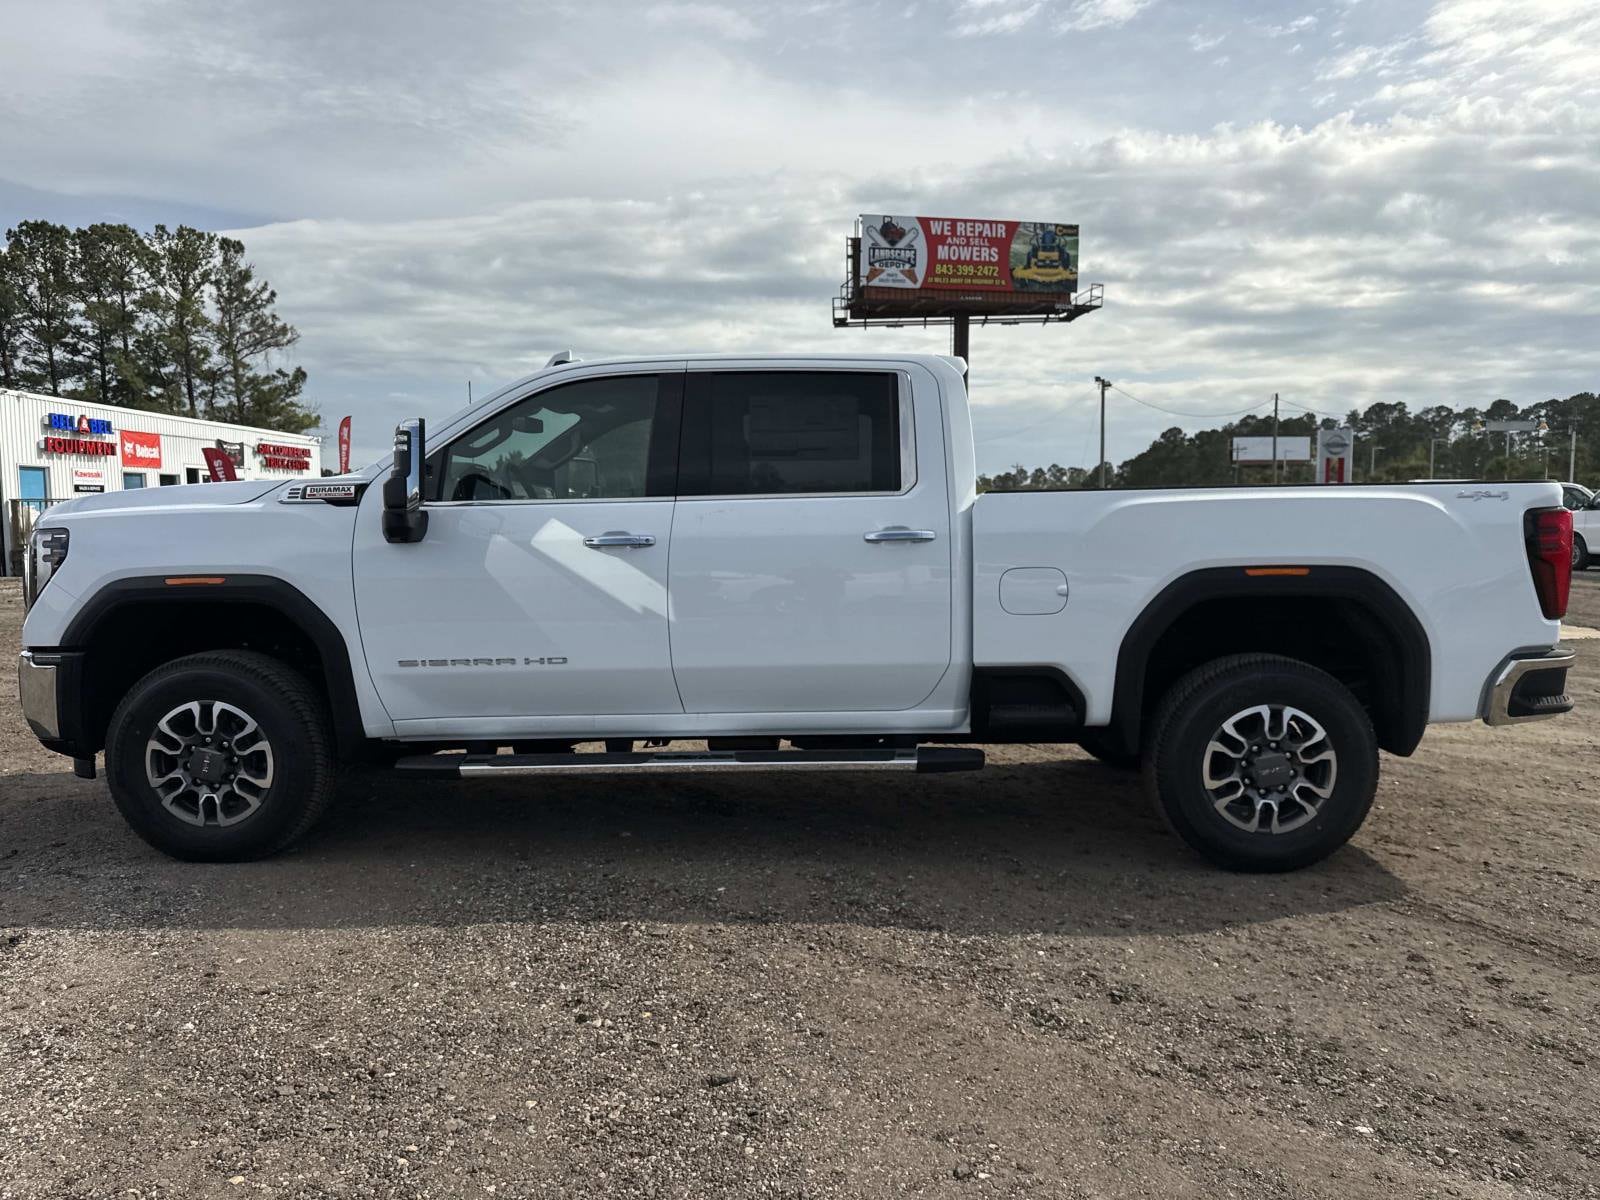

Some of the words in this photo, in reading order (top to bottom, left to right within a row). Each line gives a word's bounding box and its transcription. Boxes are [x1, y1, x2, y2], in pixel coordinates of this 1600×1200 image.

[930, 220, 952, 236] WE
[956, 221, 1006, 238] REPAIR
[946, 236, 967, 246] AND
[969, 237, 990, 247] SELL
[937, 244, 999, 262] MOWERS
[878, 261, 907, 269] DEPOT
[935, 264, 999, 277] 843-399-2472
[48, 412, 79, 431] BELL
[88, 418, 114, 435] BELL
[44, 436, 118, 456] EQUIPMENT
[135, 443, 160, 459] Bobcat
[74, 469, 103, 478] Kawasaki
[309, 486, 352, 494] DURAMAX
[398, 658, 517, 667] SIERRA
[523, 657, 568, 666] HD
